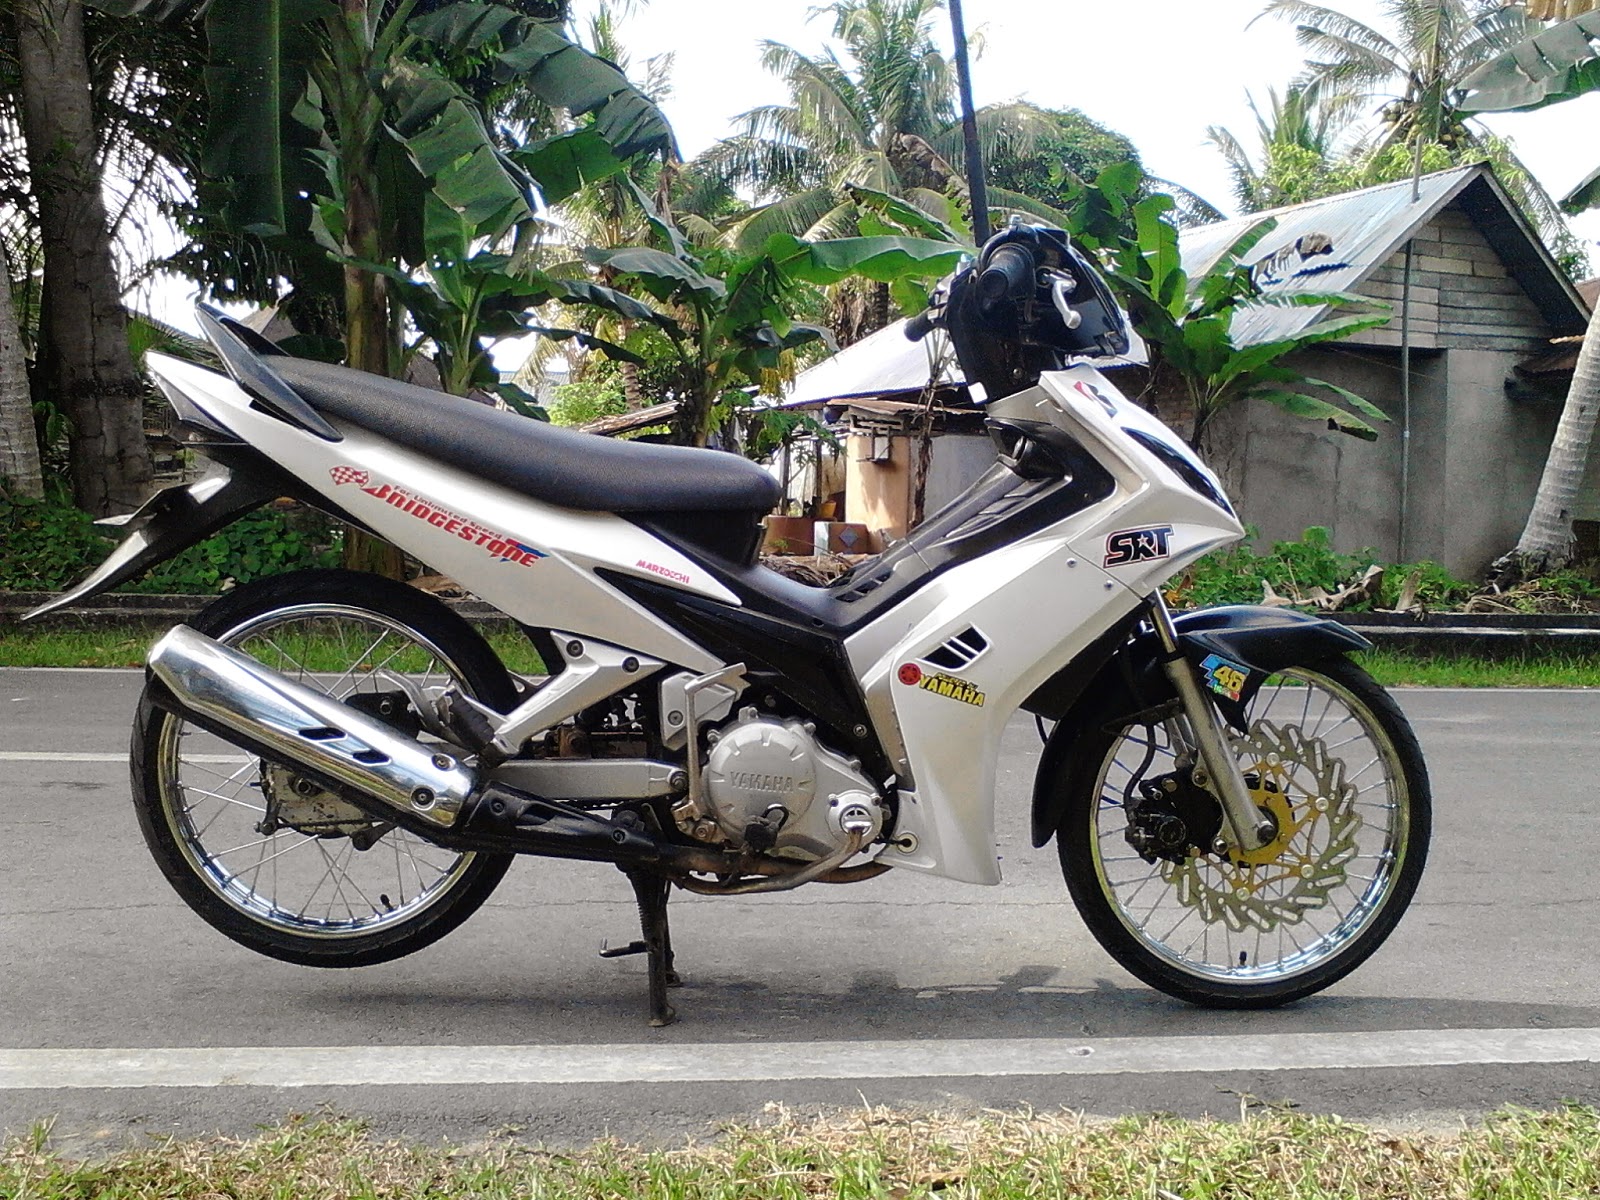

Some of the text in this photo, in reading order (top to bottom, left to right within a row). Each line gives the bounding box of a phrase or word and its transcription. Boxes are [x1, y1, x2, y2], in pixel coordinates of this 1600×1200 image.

[1105, 526, 1172, 567] SRT
[635, 559, 690, 584] MARZOCCHI
[919, 673, 986, 708] YAMAHA
[1213, 665, 1247, 693] 46
[730, 771, 794, 793] YAMAHA
